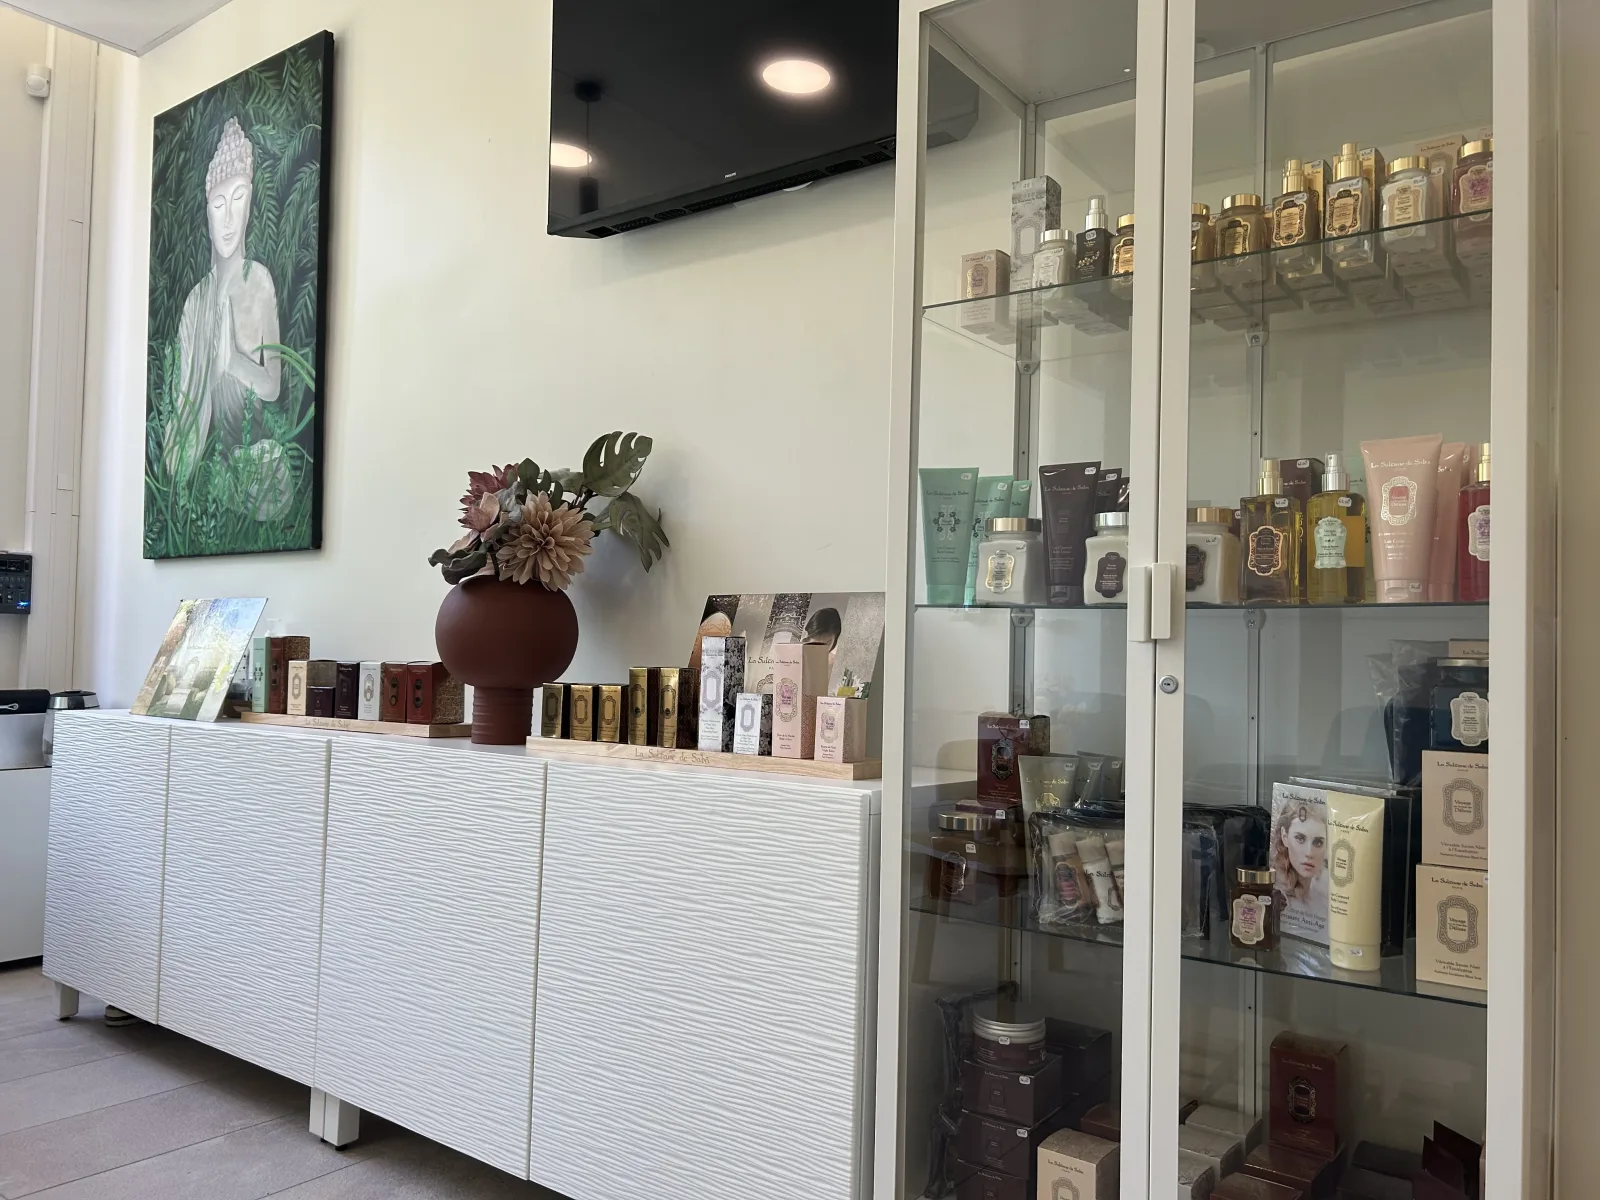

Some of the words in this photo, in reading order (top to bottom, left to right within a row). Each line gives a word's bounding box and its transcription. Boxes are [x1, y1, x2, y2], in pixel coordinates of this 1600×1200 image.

[758, 656, 774, 664] Sulta
[1446, 761, 1466, 769] Sultane
[1290, 793, 1308, 802] Sultane
[1333, 820, 1351, 829] Sultane
[1356, 825, 1369, 833] Saba
[1054, 1160, 1069, 1169] Sultane
[1074, 1166, 1084, 1174] Saba
